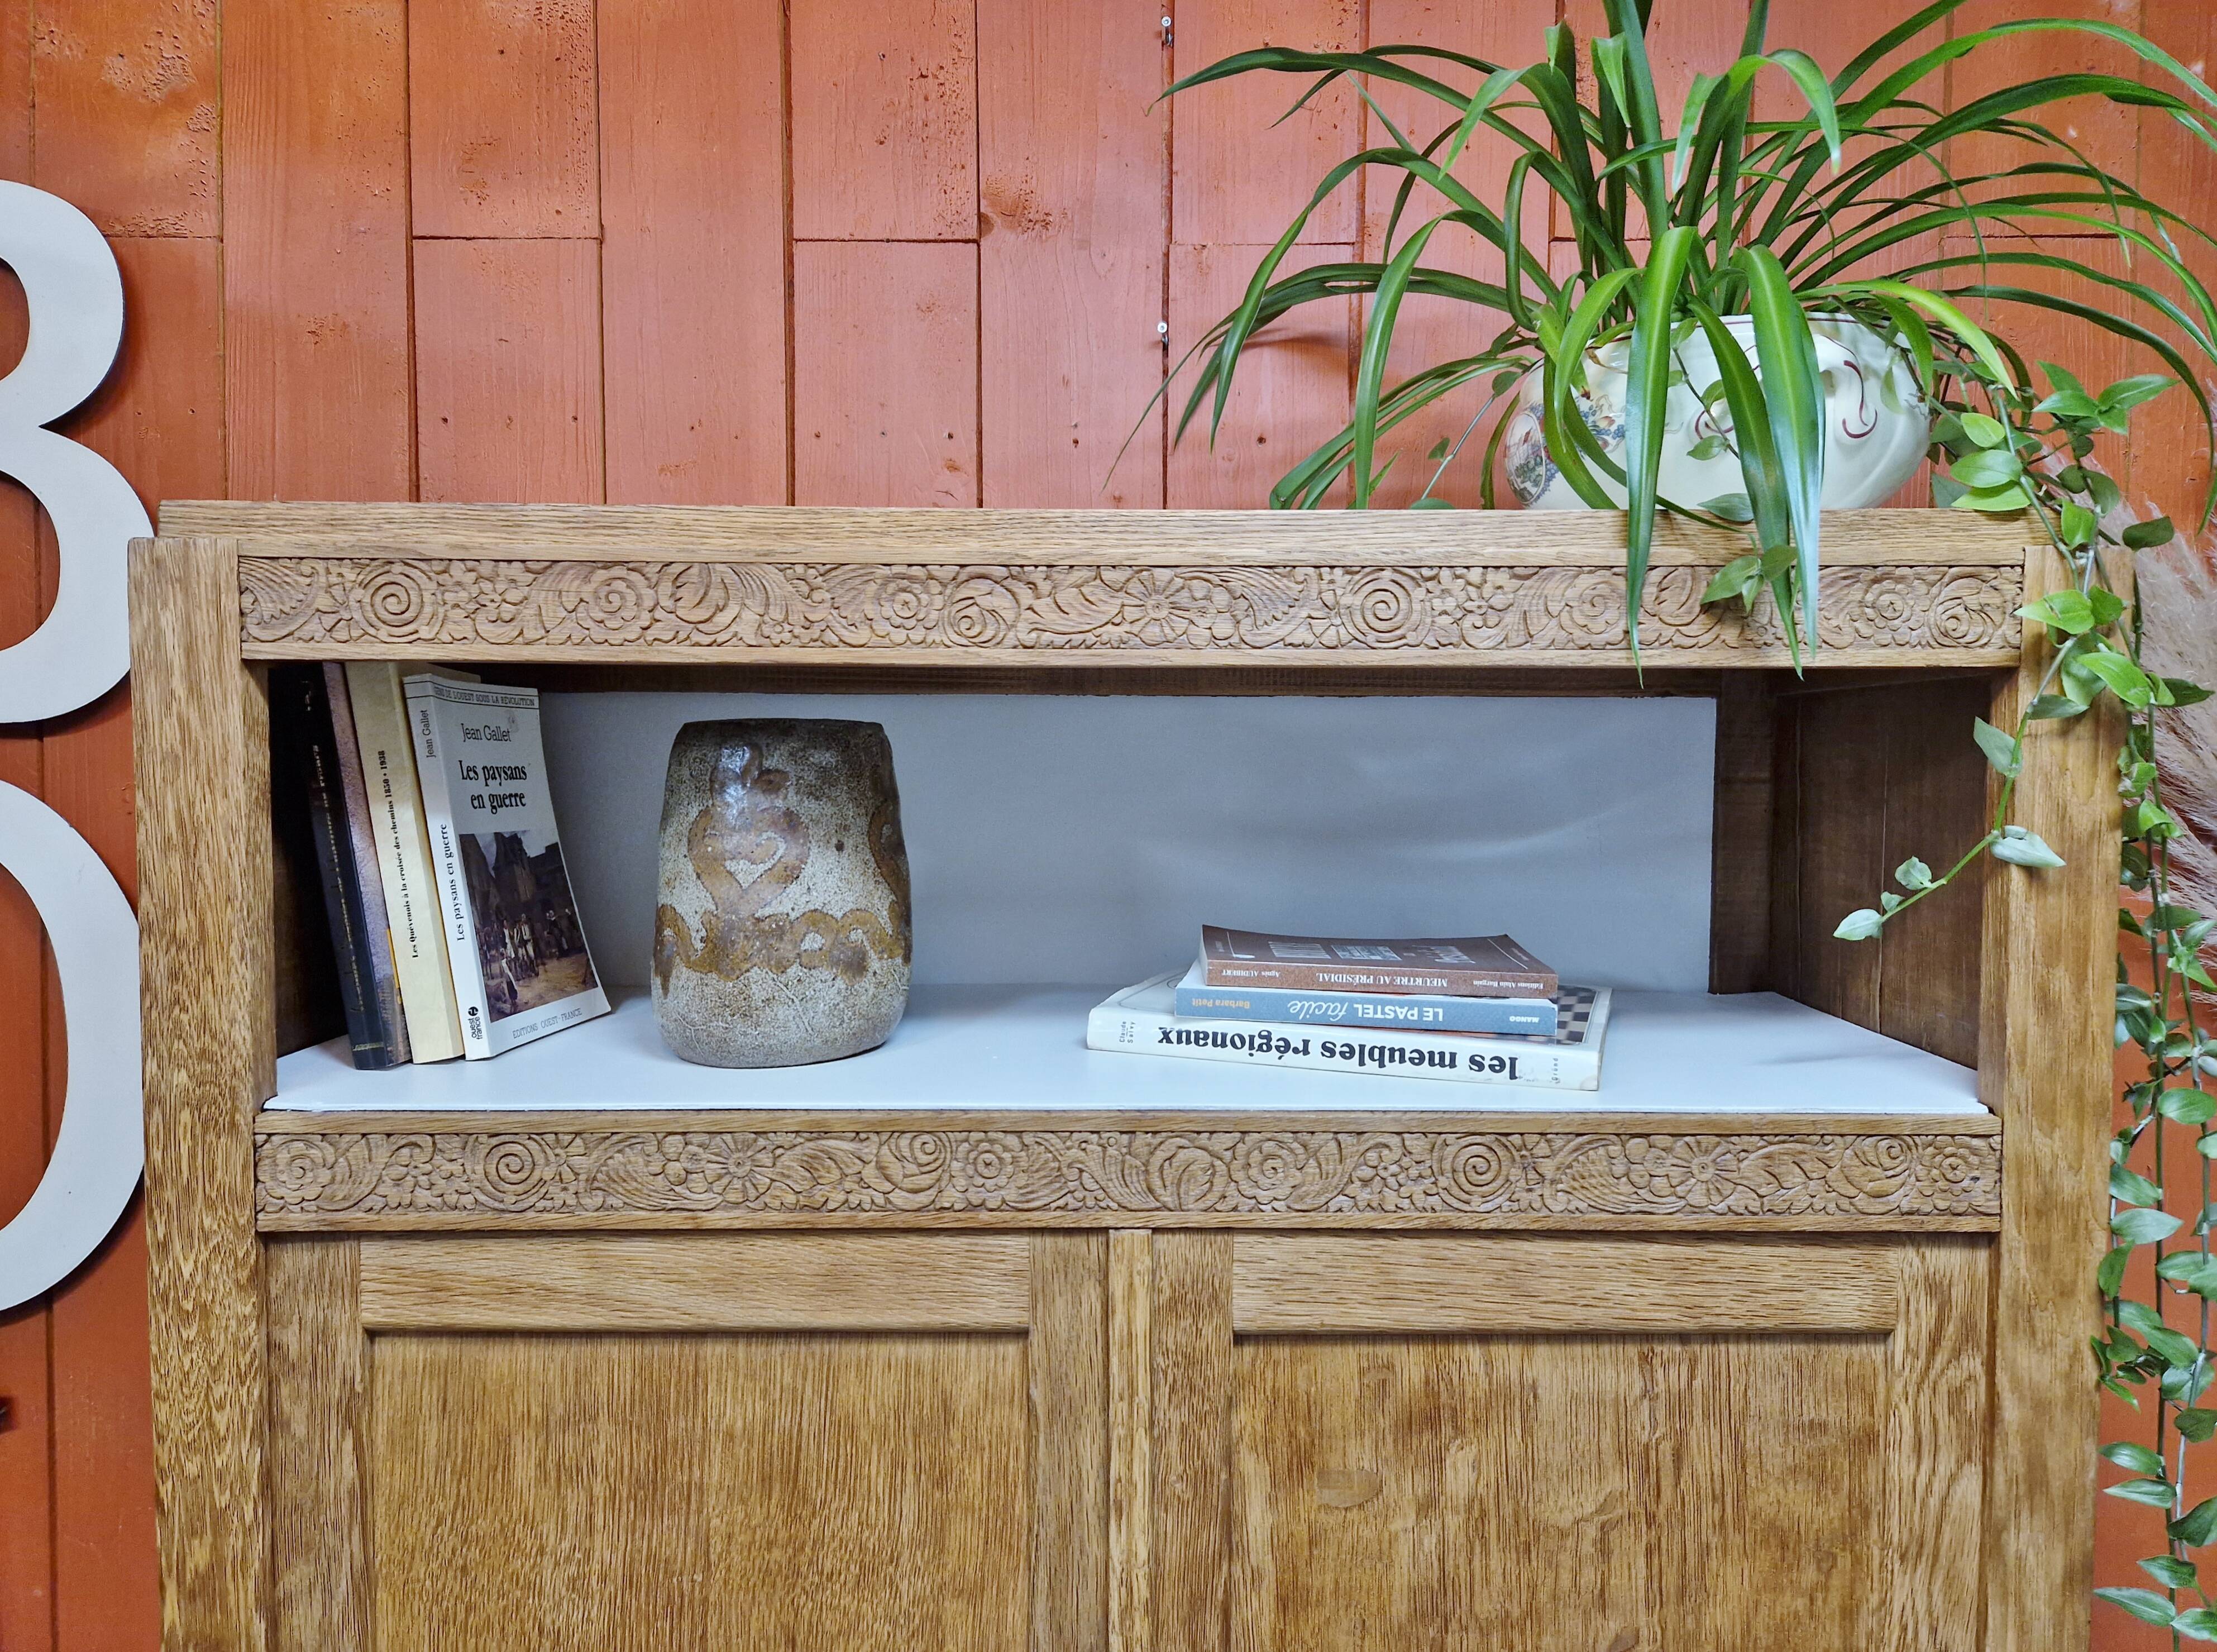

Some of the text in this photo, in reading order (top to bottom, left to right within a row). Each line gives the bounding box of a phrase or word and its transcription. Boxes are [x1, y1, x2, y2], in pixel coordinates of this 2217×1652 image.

[492, 695, 500, 704] LA
[420, 709, 437, 758] Jean Gallet
[461, 723, 512, 742] Jean Gallet
[378, 750, 388, 770] 1938
[458, 760, 527, 786] Les paysans
[383, 779, 392, 798] 1850
[471, 791, 526, 814] en guerre
[388, 800, 398, 834] chemins
[441, 824, 454, 858] guerre
[395, 852, 405, 881] croisée
[447, 863, 454, 875] en
[449, 878, 464, 920] paysans
[404, 900, 417, 942] Quévenois
[1222, 969, 1259, 977] AUDIBERT
[1316, 972, 1448, 987] MEURTRE AU PRÉSIDIAL
[1192, 997, 1251, 1009] Barbara Petit
[1287, 1000, 1444, 1022] LE PASTEL facile
[468, 1017, 477, 1038] ouest
[475, 1016, 483, 1040] france
[513, 1023, 538, 1039] EDITIONS
[1127, 1021, 1136, 1044] Salvy
[1157, 1026, 1519, 1080] les meubles régionaux
